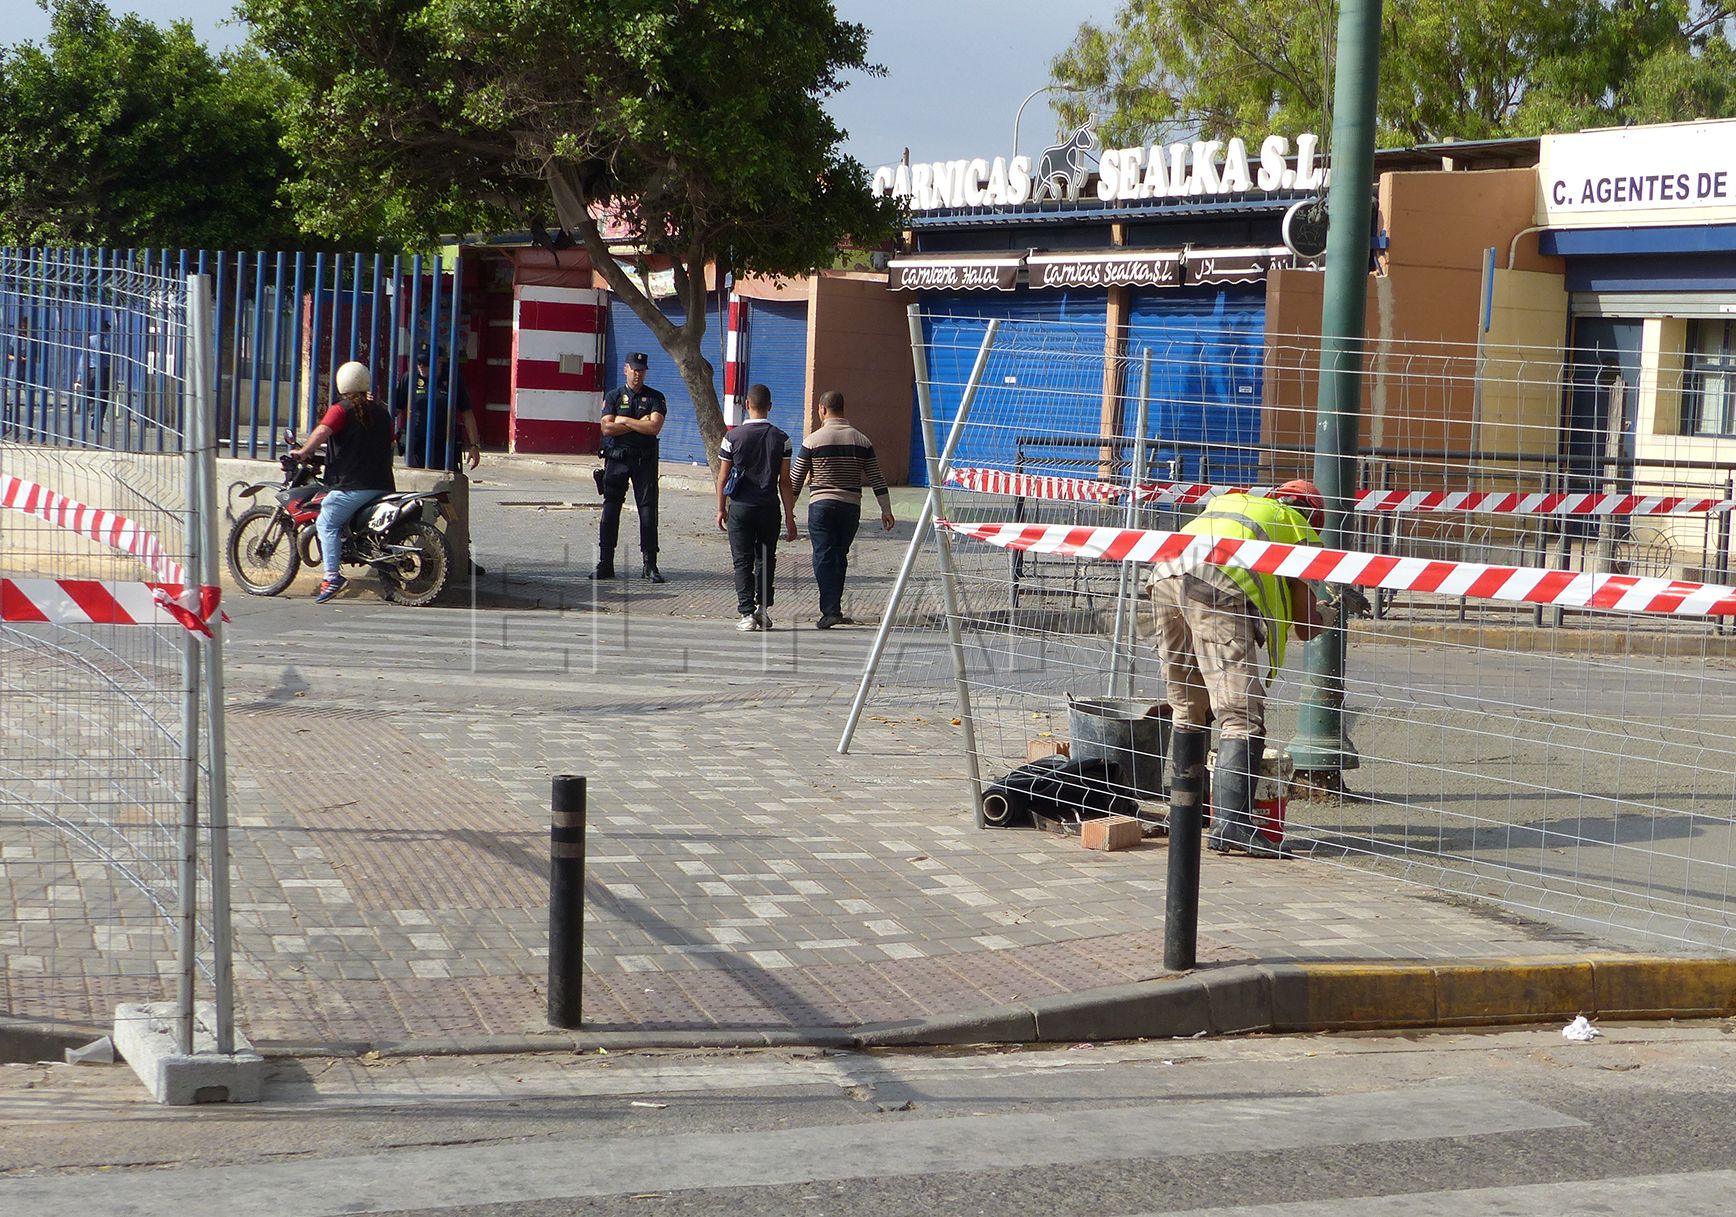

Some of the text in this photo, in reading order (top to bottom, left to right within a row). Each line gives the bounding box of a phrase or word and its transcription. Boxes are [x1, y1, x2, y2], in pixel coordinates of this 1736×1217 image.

[872, 155, 1032, 210] CARNICAS
[1096, 137, 1254, 202] SEALKA
[1553, 171, 1728, 205] C. AGENTES DE
[961, 265, 1000, 285] Halal
